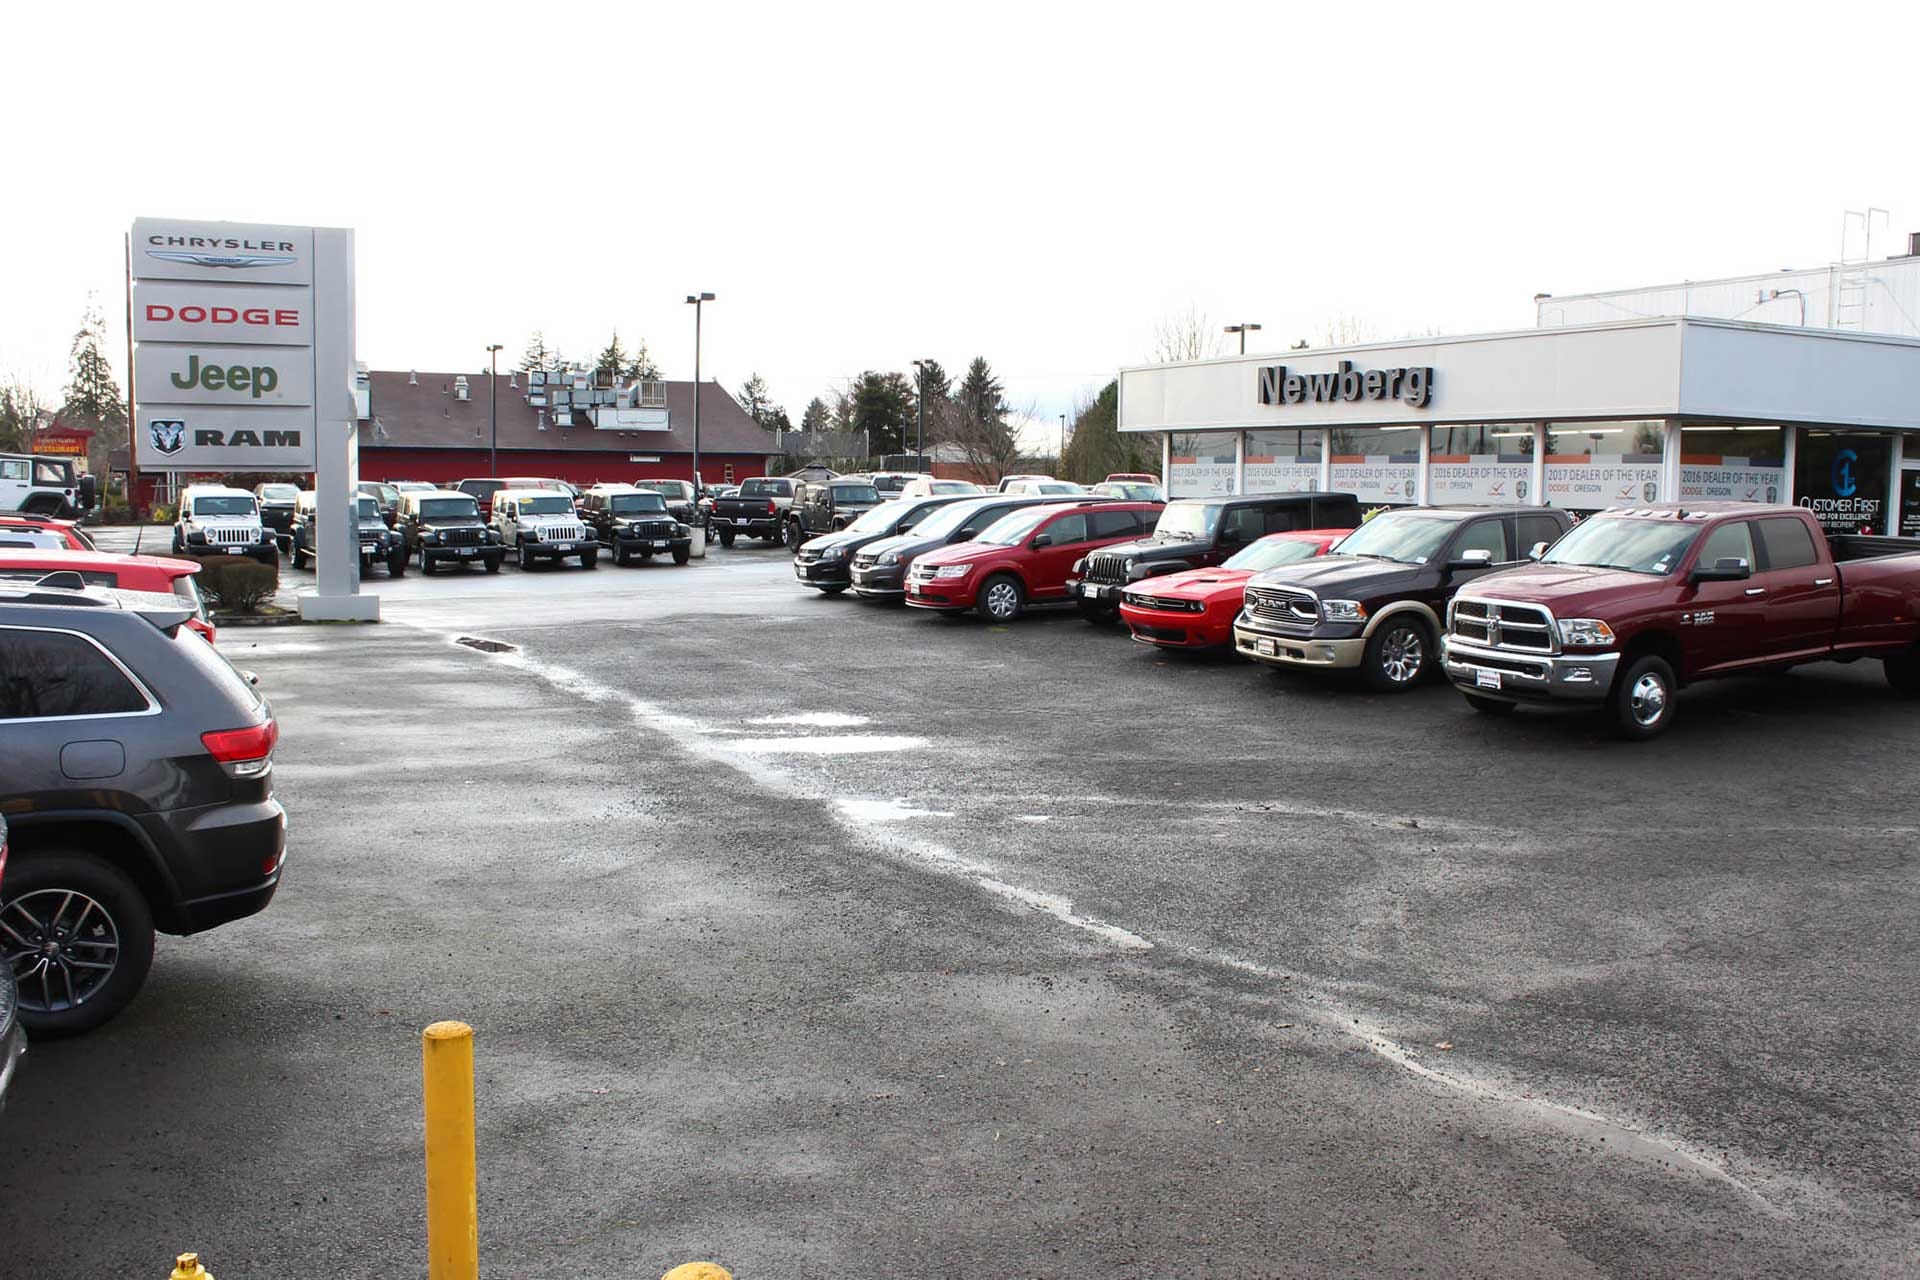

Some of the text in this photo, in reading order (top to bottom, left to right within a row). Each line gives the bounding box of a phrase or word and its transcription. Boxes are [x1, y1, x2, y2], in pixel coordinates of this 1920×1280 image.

[148, 235, 294, 251] CHRYSLER
[146, 305, 299, 326] DODGE
[171, 355, 278, 398] Jeep
[1257, 360, 1434, 408] Newberg
[195, 430, 301, 447] RAM
[1350, 468, 1375, 479] DEALER
[1375, 468, 1384, 479] OF
[1385, 468, 1398, 479] THE
[1400, 468, 1415, 479] YEAR
[1434, 467, 1528, 478] 2016 DEALER OF THE YEAR
[1548, 469, 1658, 480] 2017 DEALER OF THE YEAR
[1682, 471, 1778, 485] 2016 DEALER OF THE YEAR
[1449, 481, 1472, 489] OREGON
[1548, 484, 1602, 492] DODGE OREGON
[1681, 486, 1731, 496] DODGE OREGON
[1854, 498, 1880, 512] FIRST
[1258, 597, 1287, 609] RAM
